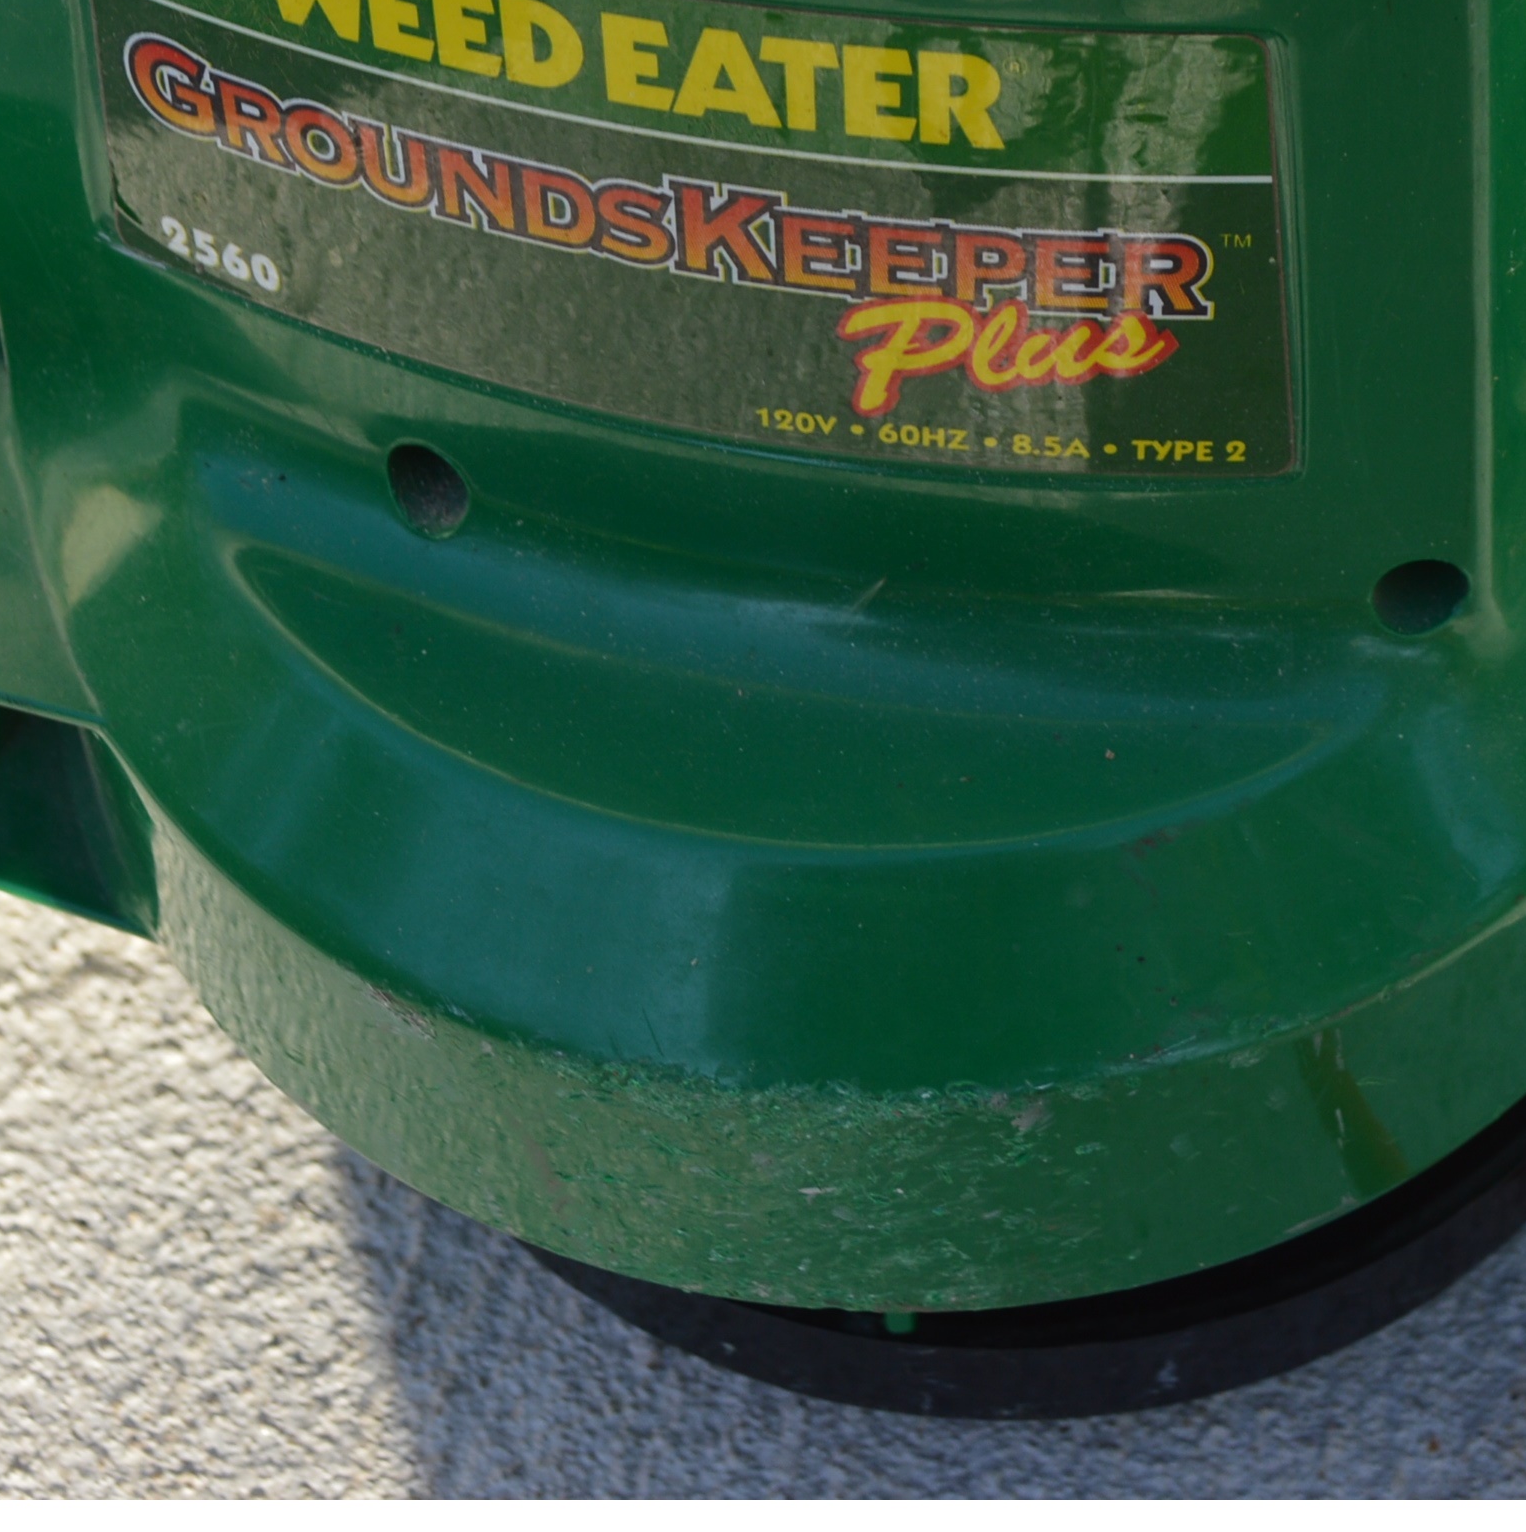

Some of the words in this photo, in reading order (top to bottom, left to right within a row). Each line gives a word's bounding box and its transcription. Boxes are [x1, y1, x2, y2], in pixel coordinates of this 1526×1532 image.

[601, 12, 1005, 150] EATER
[123, 32, 1215, 321] GROUNDSKEEPER
[161, 215, 282, 292] 2560
[836, 296, 1180, 417] Plus
[756, 406, 838, 435] 120V
[878, 422, 970, 451] 60HZ
[1012, 433, 1091, 459] 8.5A
[1131, 439, 1213, 462] TYPE
[1226, 440, 1246, 462] 2
